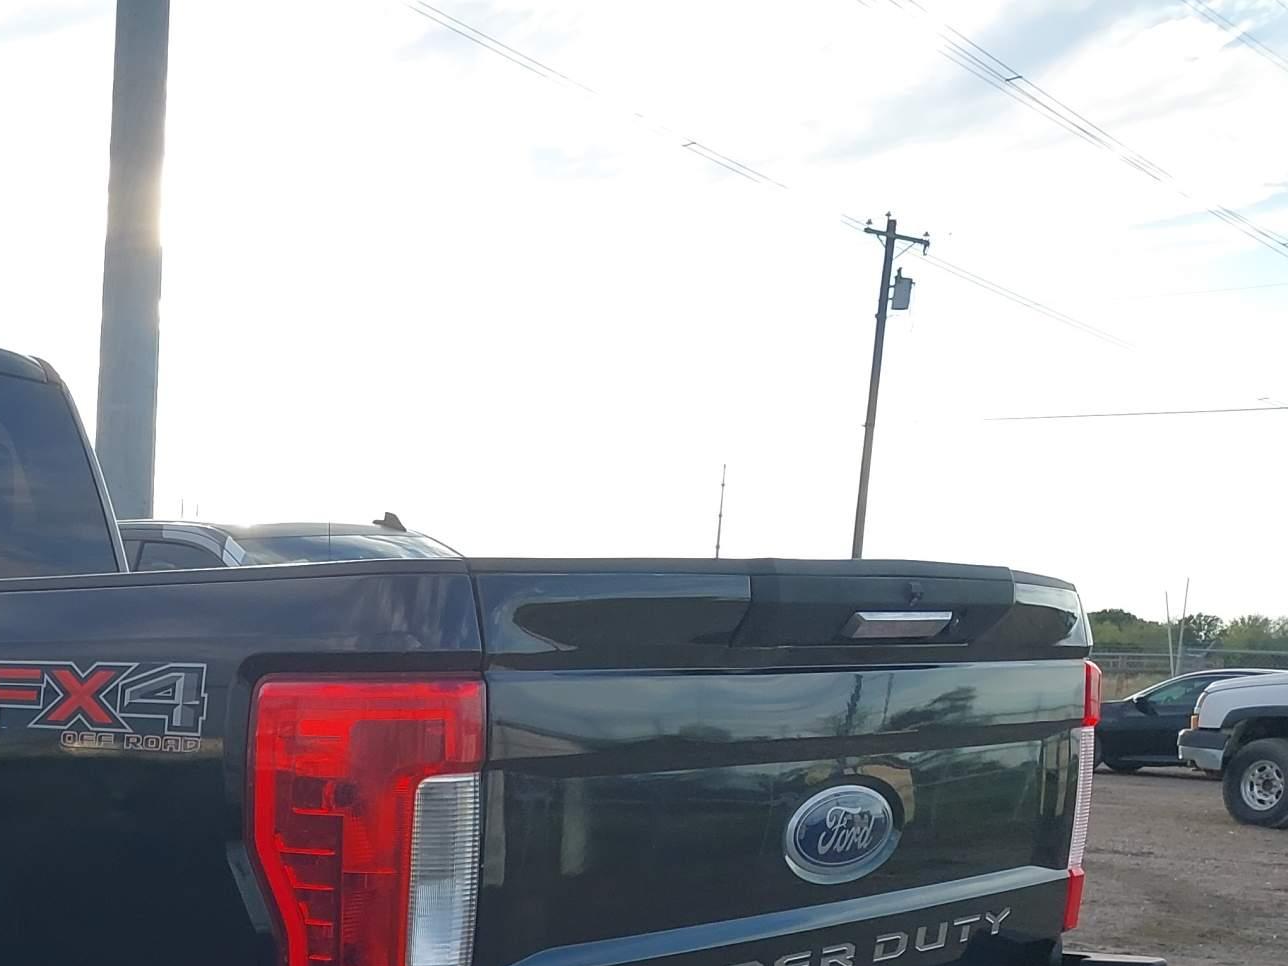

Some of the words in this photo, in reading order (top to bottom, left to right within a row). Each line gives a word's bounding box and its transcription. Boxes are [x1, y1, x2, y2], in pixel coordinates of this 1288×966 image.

[61, 730, 114, 749] OFF
[124, 735, 200, 752] ROAD
[817, 806, 874, 855] Ford
[872, 906, 1011, 963] DUTY
